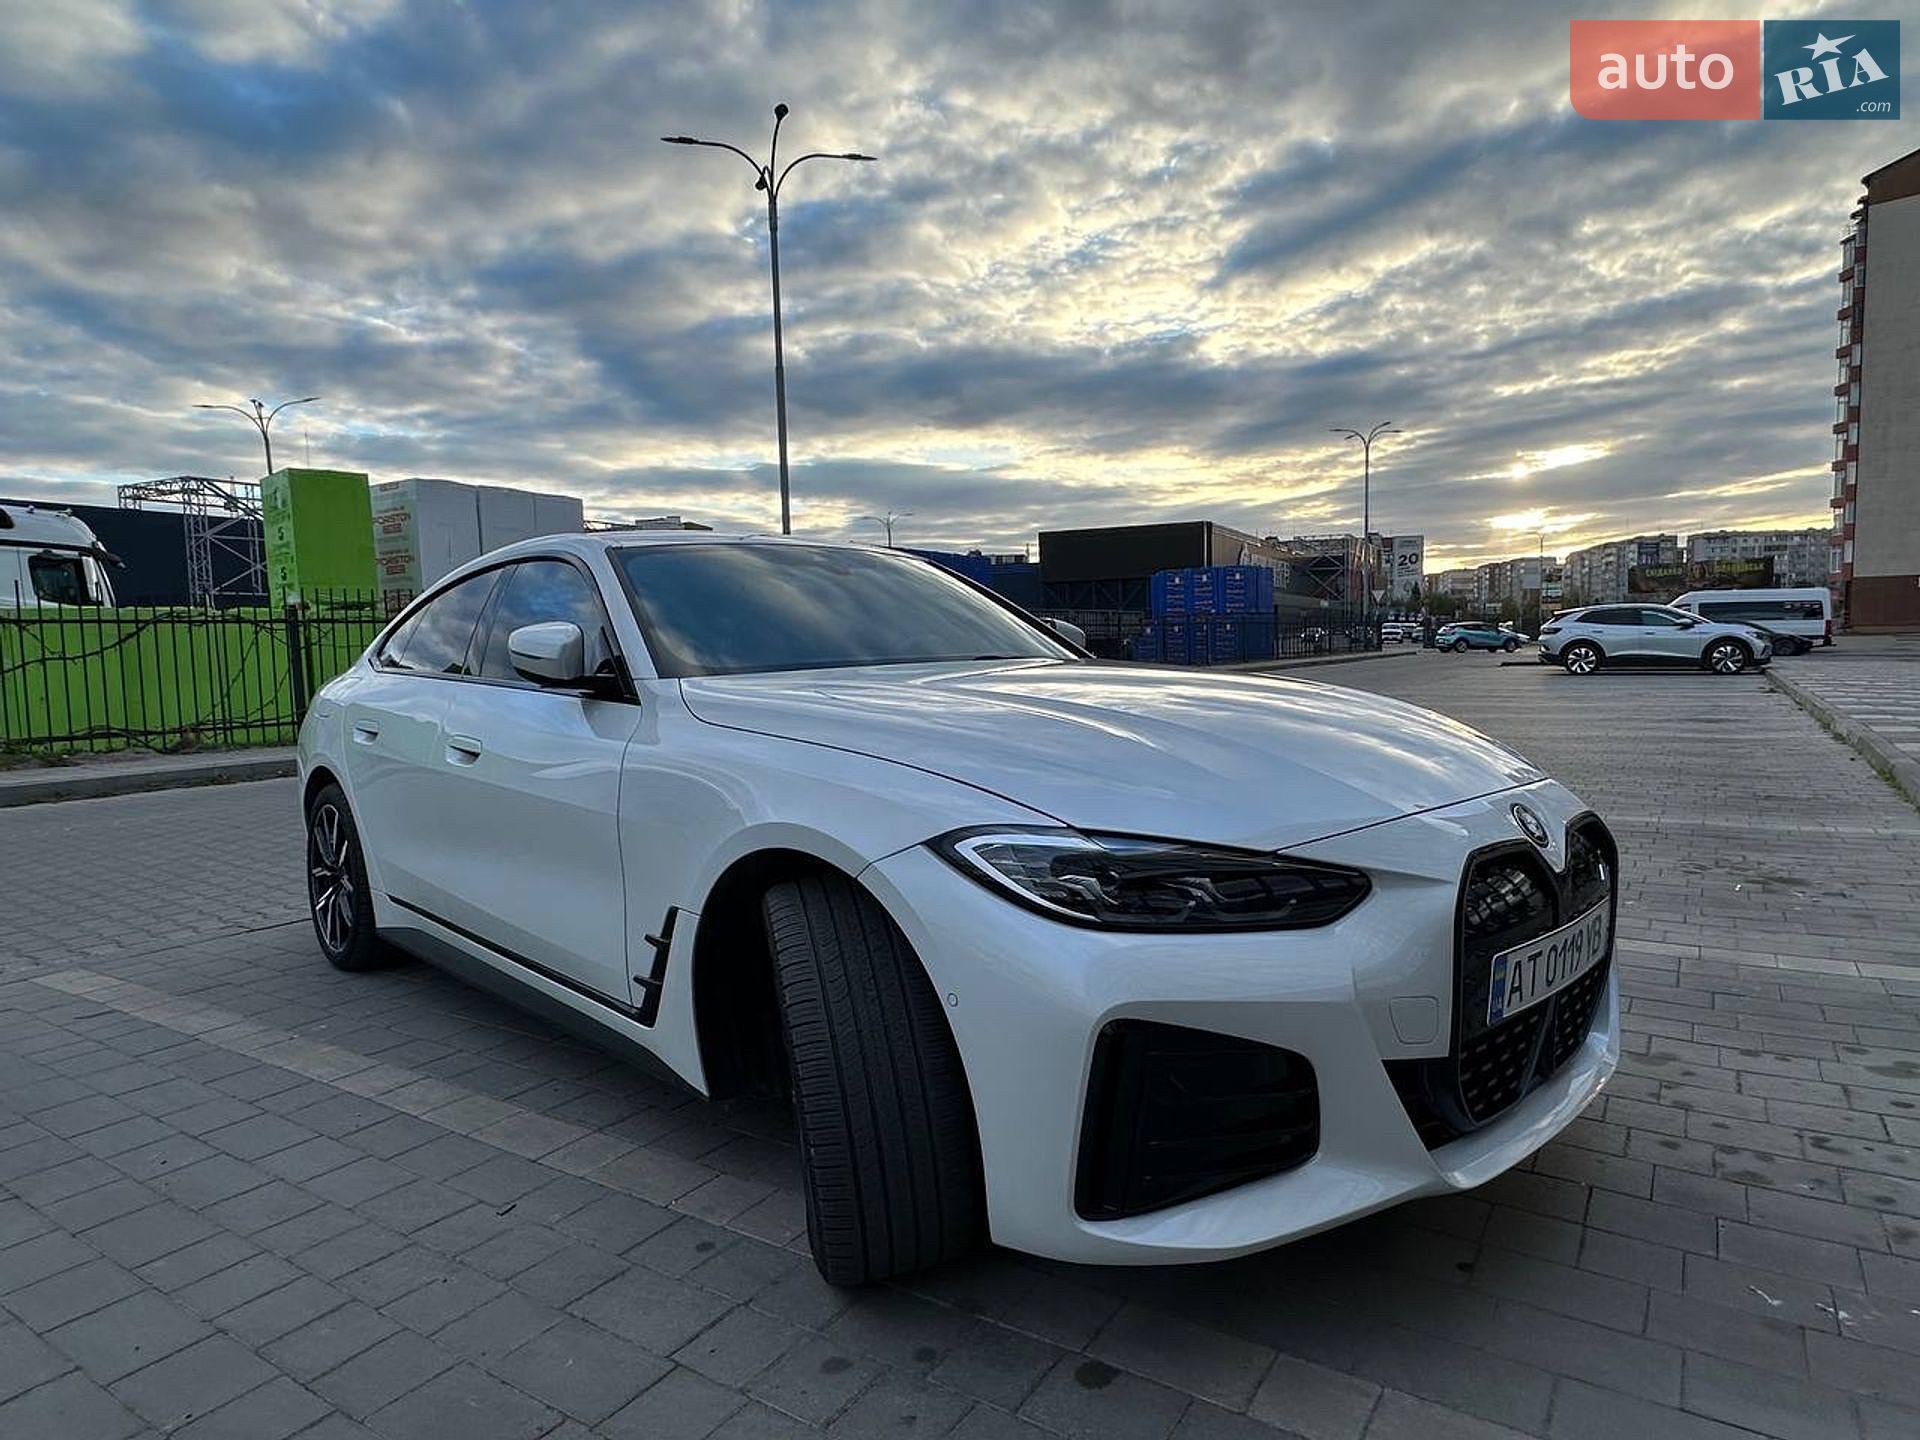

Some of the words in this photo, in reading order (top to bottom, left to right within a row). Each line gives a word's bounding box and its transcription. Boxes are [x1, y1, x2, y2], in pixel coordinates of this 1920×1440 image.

[1397, 552, 1419, 567] 20
[1507, 949, 1543, 1008] AT
[1545, 929, 1584, 987] 0119
